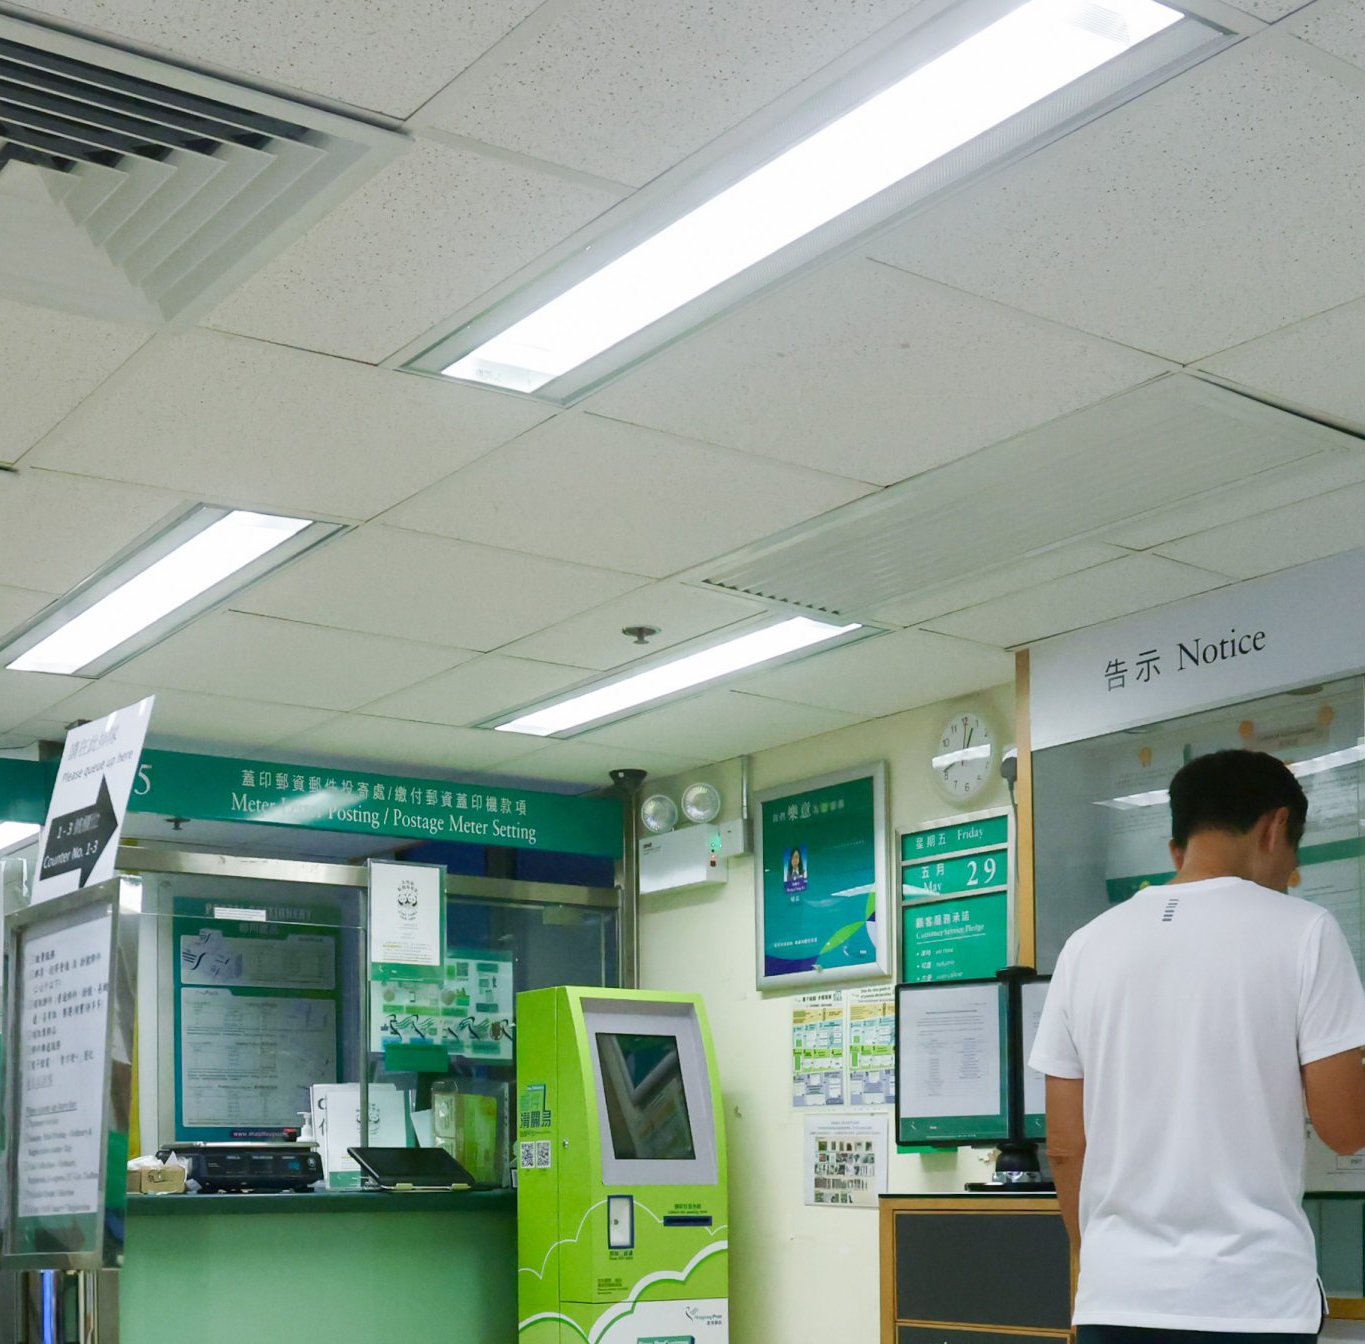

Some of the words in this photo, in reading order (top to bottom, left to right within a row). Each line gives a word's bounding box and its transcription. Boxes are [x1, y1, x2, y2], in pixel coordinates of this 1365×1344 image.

[1105, 648, 1161, 692] 告示
[1177, 627, 1266, 674] Notice
[61, 770, 84, 784] Please
[84, 761, 106, 778] queue
[106, 756, 117, 769] up
[118, 750, 133, 763] here
[134, 763, 153, 795] 5
[231, 792, 275, 812] Meter
[328, 806, 380, 829] Posting
[393, 808, 444, 834] Postage
[449, 815, 487, 835] Meter
[492, 819, 537, 845] Setting
[916, 833, 946, 849] 星期五
[957, 826, 984, 841] Friday
[43, 849, 70, 869] Counter
[72, 846, 84, 859] No.
[85, 839, 99, 855] 1-3
[921, 862, 945, 879] 五月
[966, 857, 996, 887] 29
[923, 881, 942, 895] May
